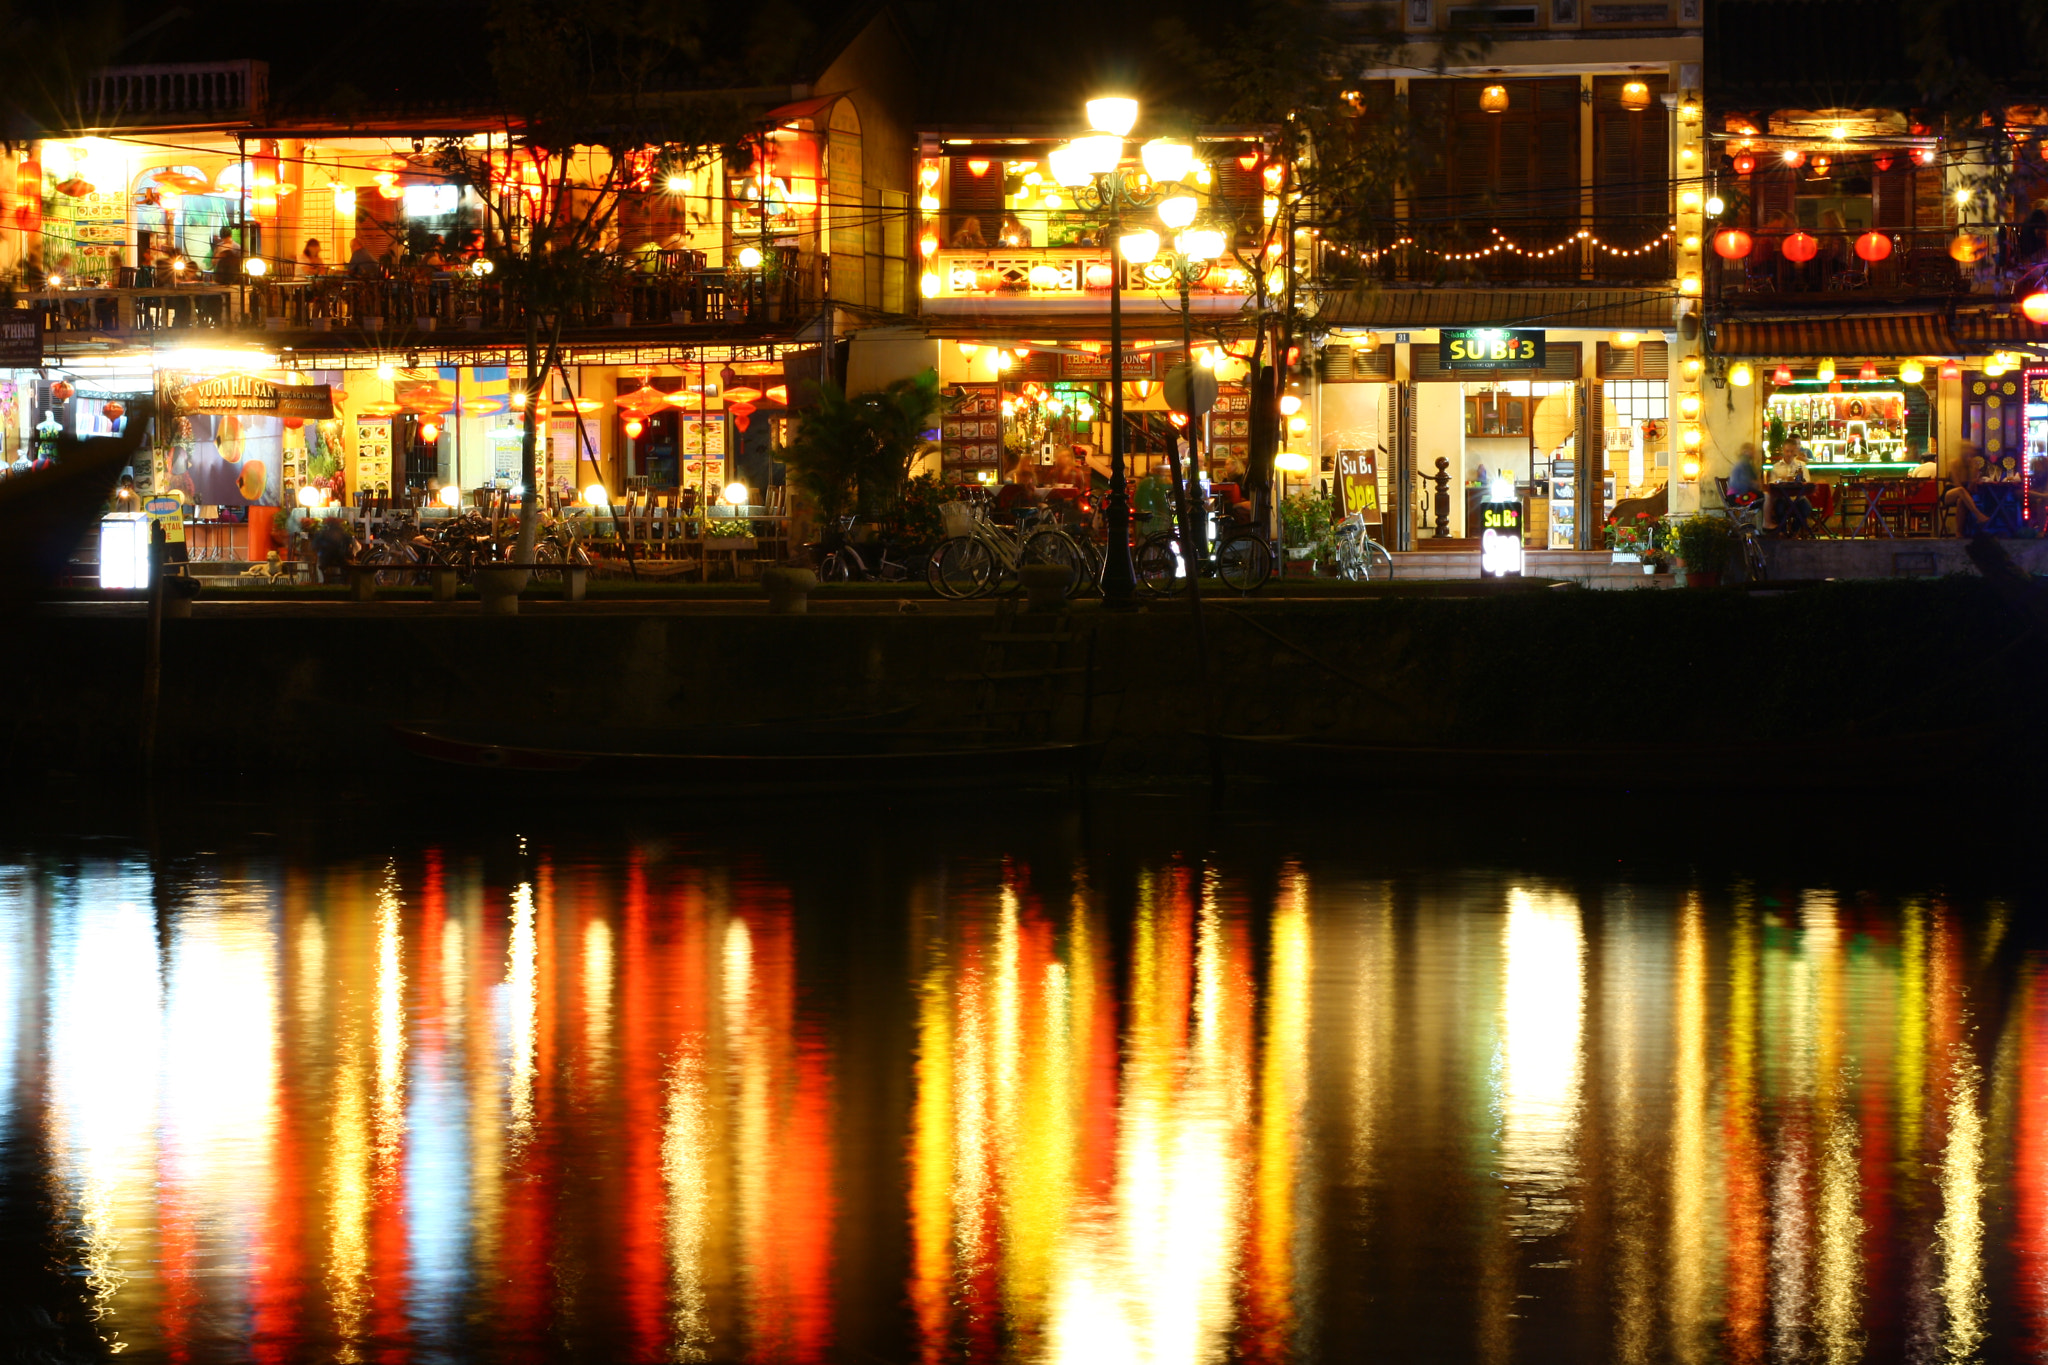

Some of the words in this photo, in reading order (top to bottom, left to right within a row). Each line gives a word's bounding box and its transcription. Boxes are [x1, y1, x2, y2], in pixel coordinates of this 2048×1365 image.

[1520, 340, 1535, 360] 3
[199, 398, 238, 408] SEAFOOD
[241, 399, 276, 409] GARDEN
[1342, 455, 1357, 475] Su
[1346, 475, 1377, 512] Spa
[1484, 509, 1501, 527] Su
